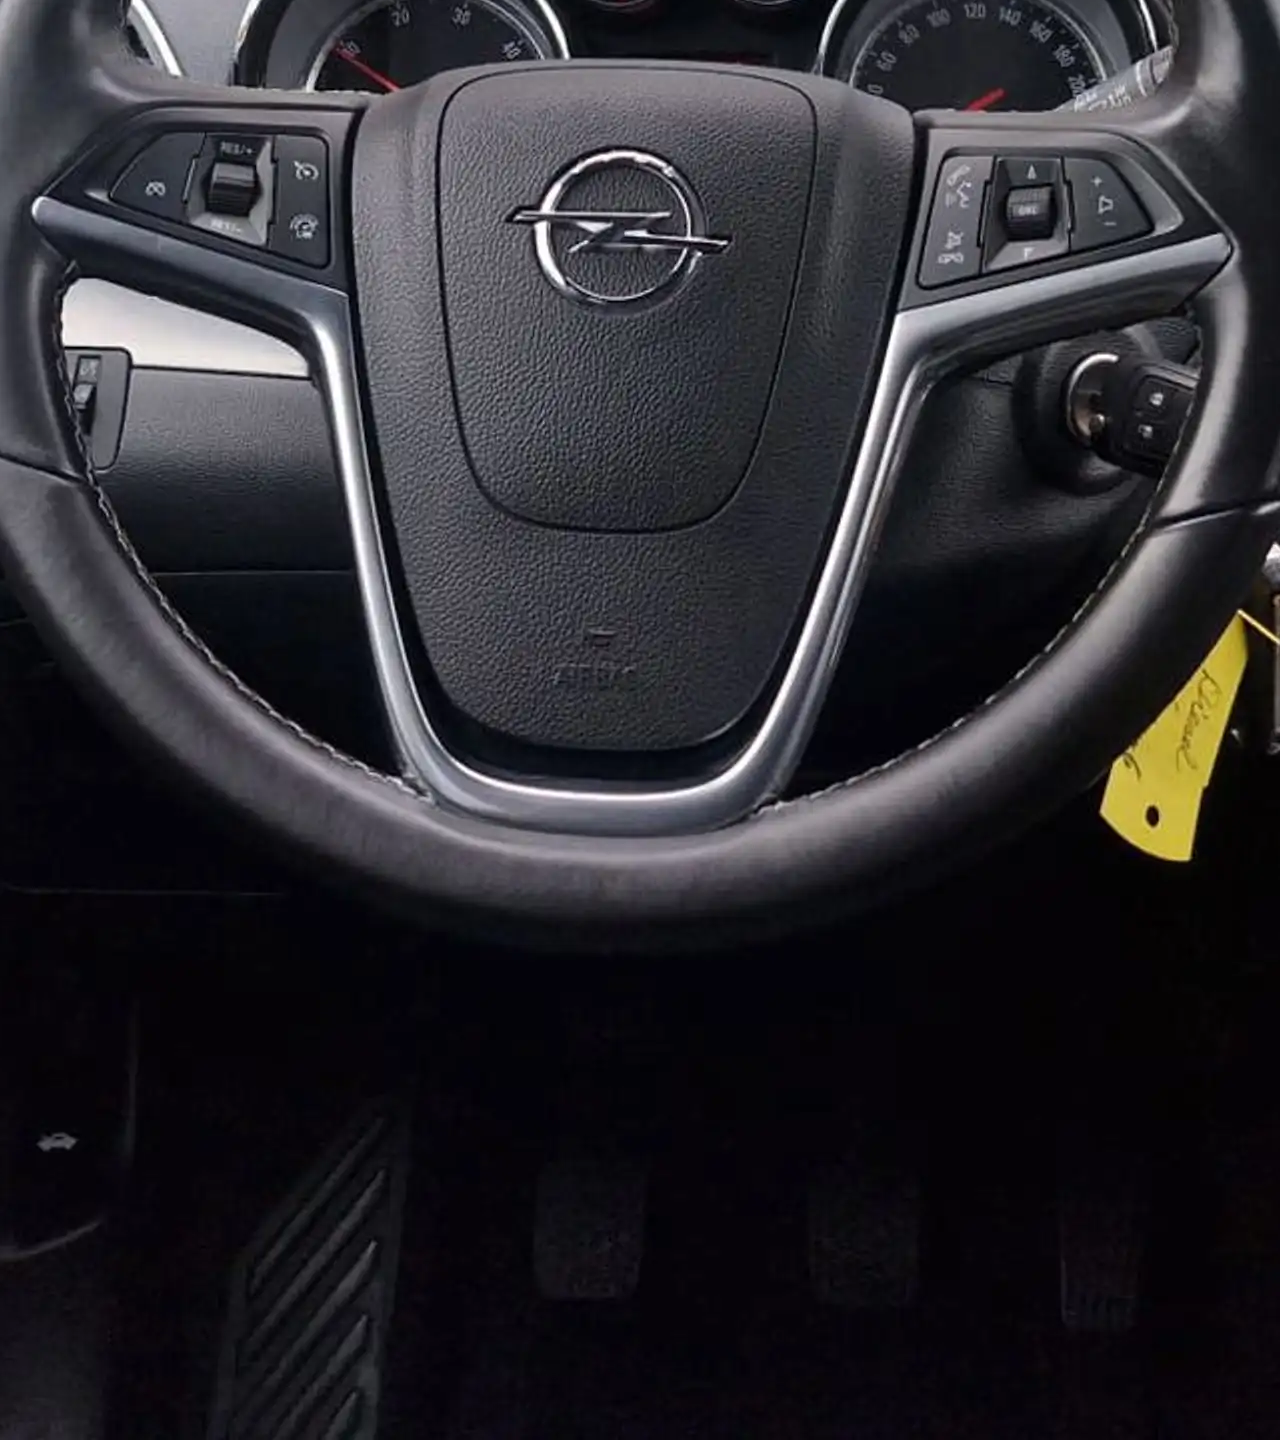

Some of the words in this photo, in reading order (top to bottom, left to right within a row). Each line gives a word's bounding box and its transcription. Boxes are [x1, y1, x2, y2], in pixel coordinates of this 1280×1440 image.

[391, 8, 410, 27] 20
[964, 2, 986, 19] 120
[999, 6, 1021, 27] 140
